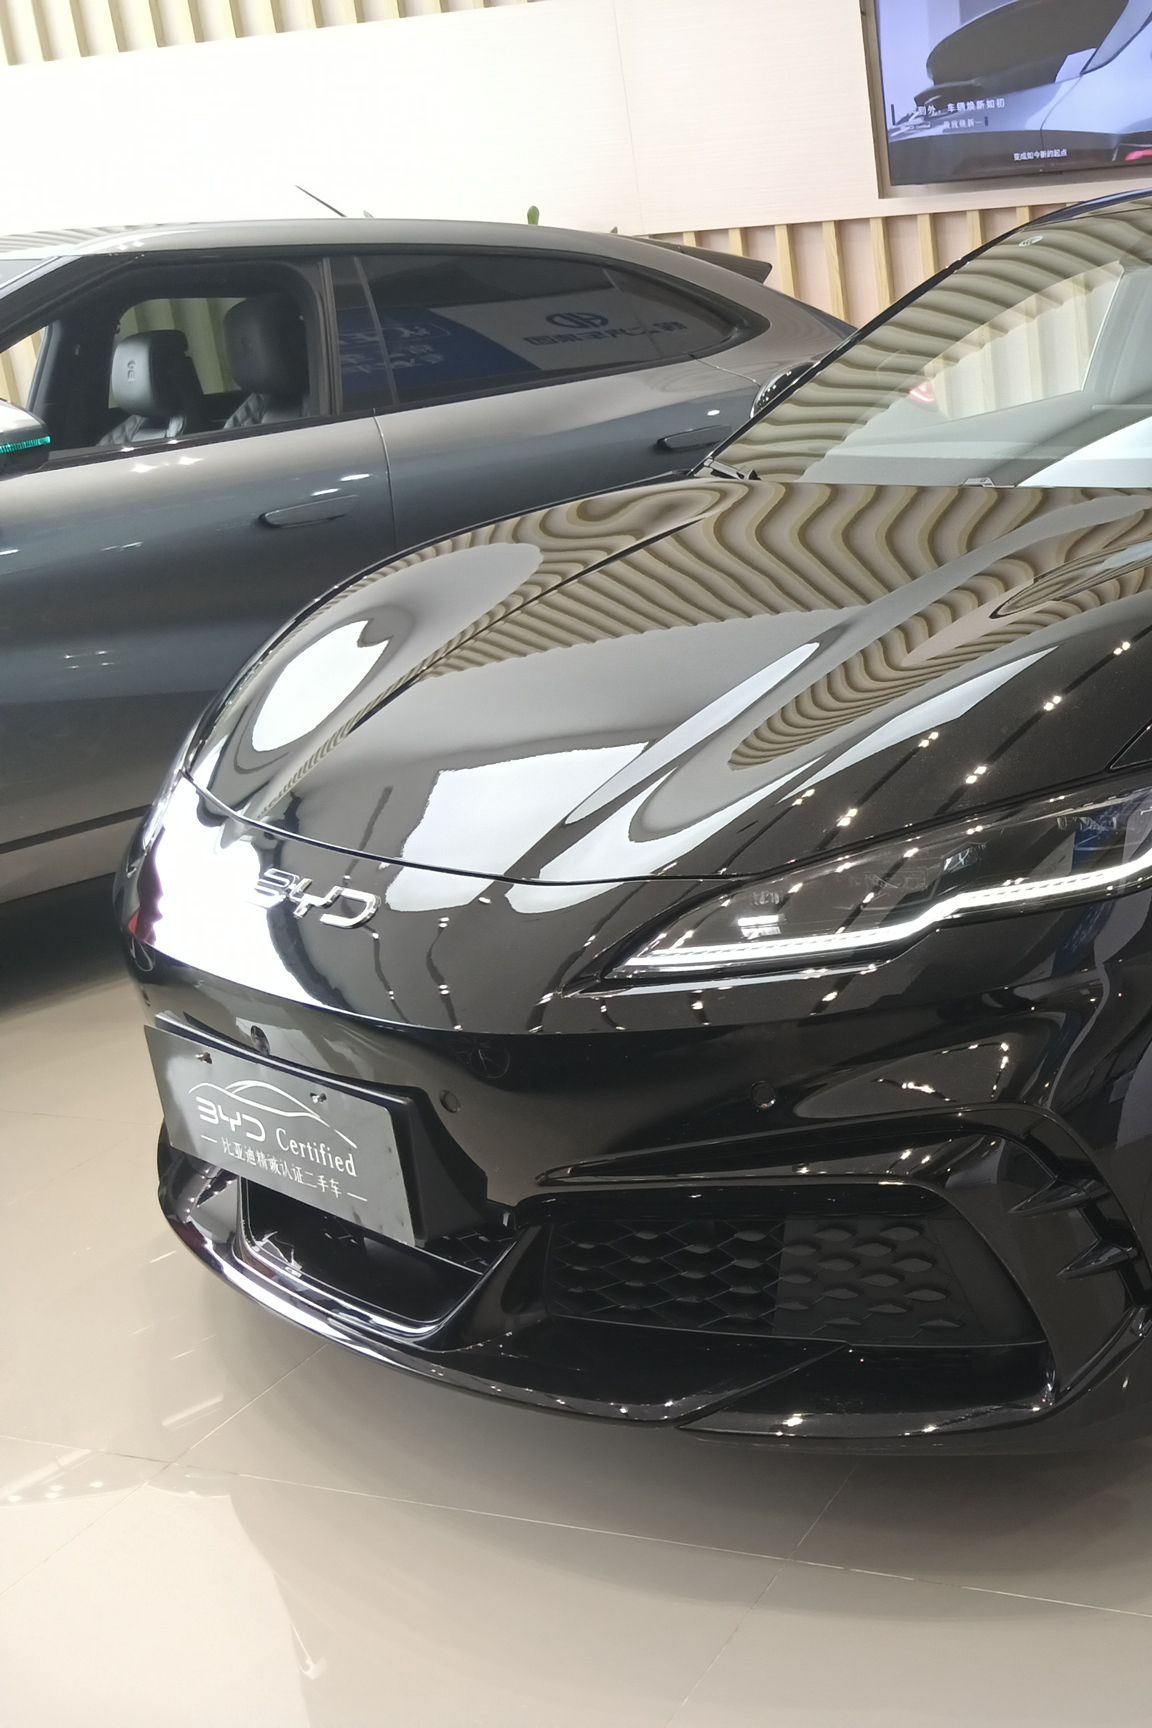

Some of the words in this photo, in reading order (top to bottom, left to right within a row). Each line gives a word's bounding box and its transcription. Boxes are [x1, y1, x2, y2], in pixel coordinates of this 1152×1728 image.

[254, 868, 382, 928] BYD
[196, 1097, 266, 1142] BYD
[275, 1128, 357, 1178] Certified
